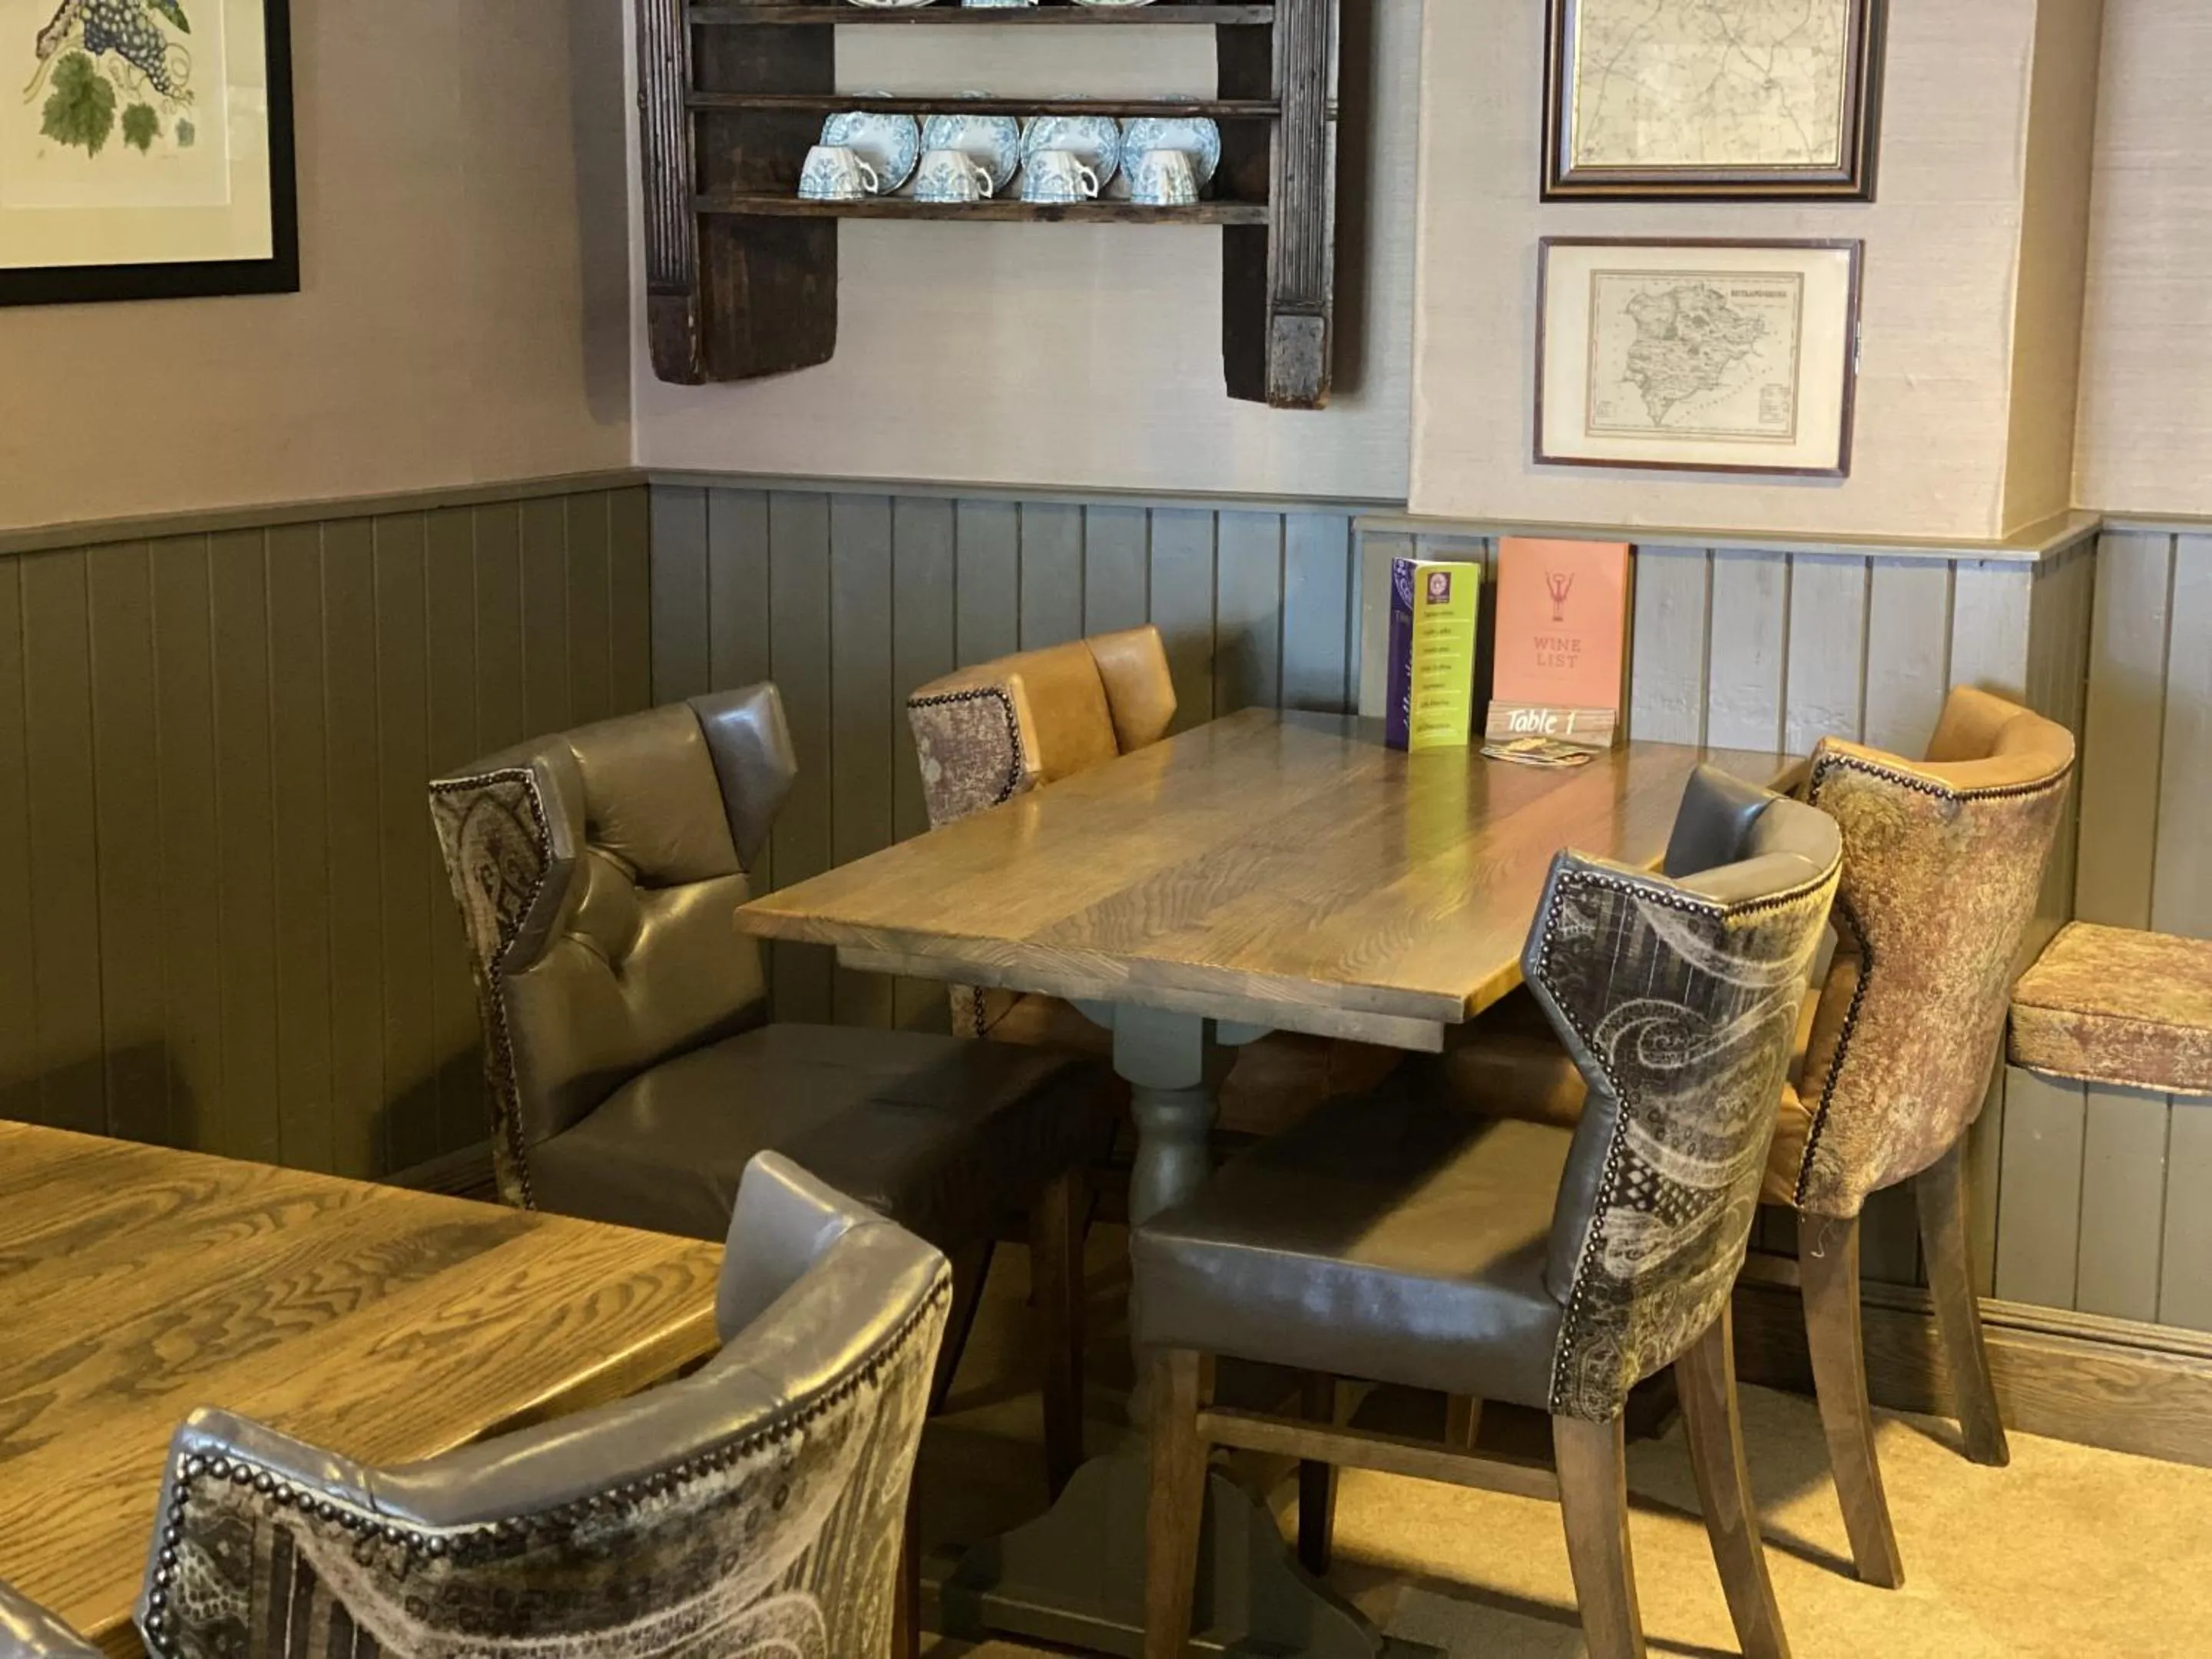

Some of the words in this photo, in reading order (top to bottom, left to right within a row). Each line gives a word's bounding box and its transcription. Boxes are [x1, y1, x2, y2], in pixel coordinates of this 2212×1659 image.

[1534, 636, 1581, 652] WINE
[1537, 653, 1578, 668] LIST
[1506, 708, 1558, 734] Table
[1565, 709, 1577, 735] 1
